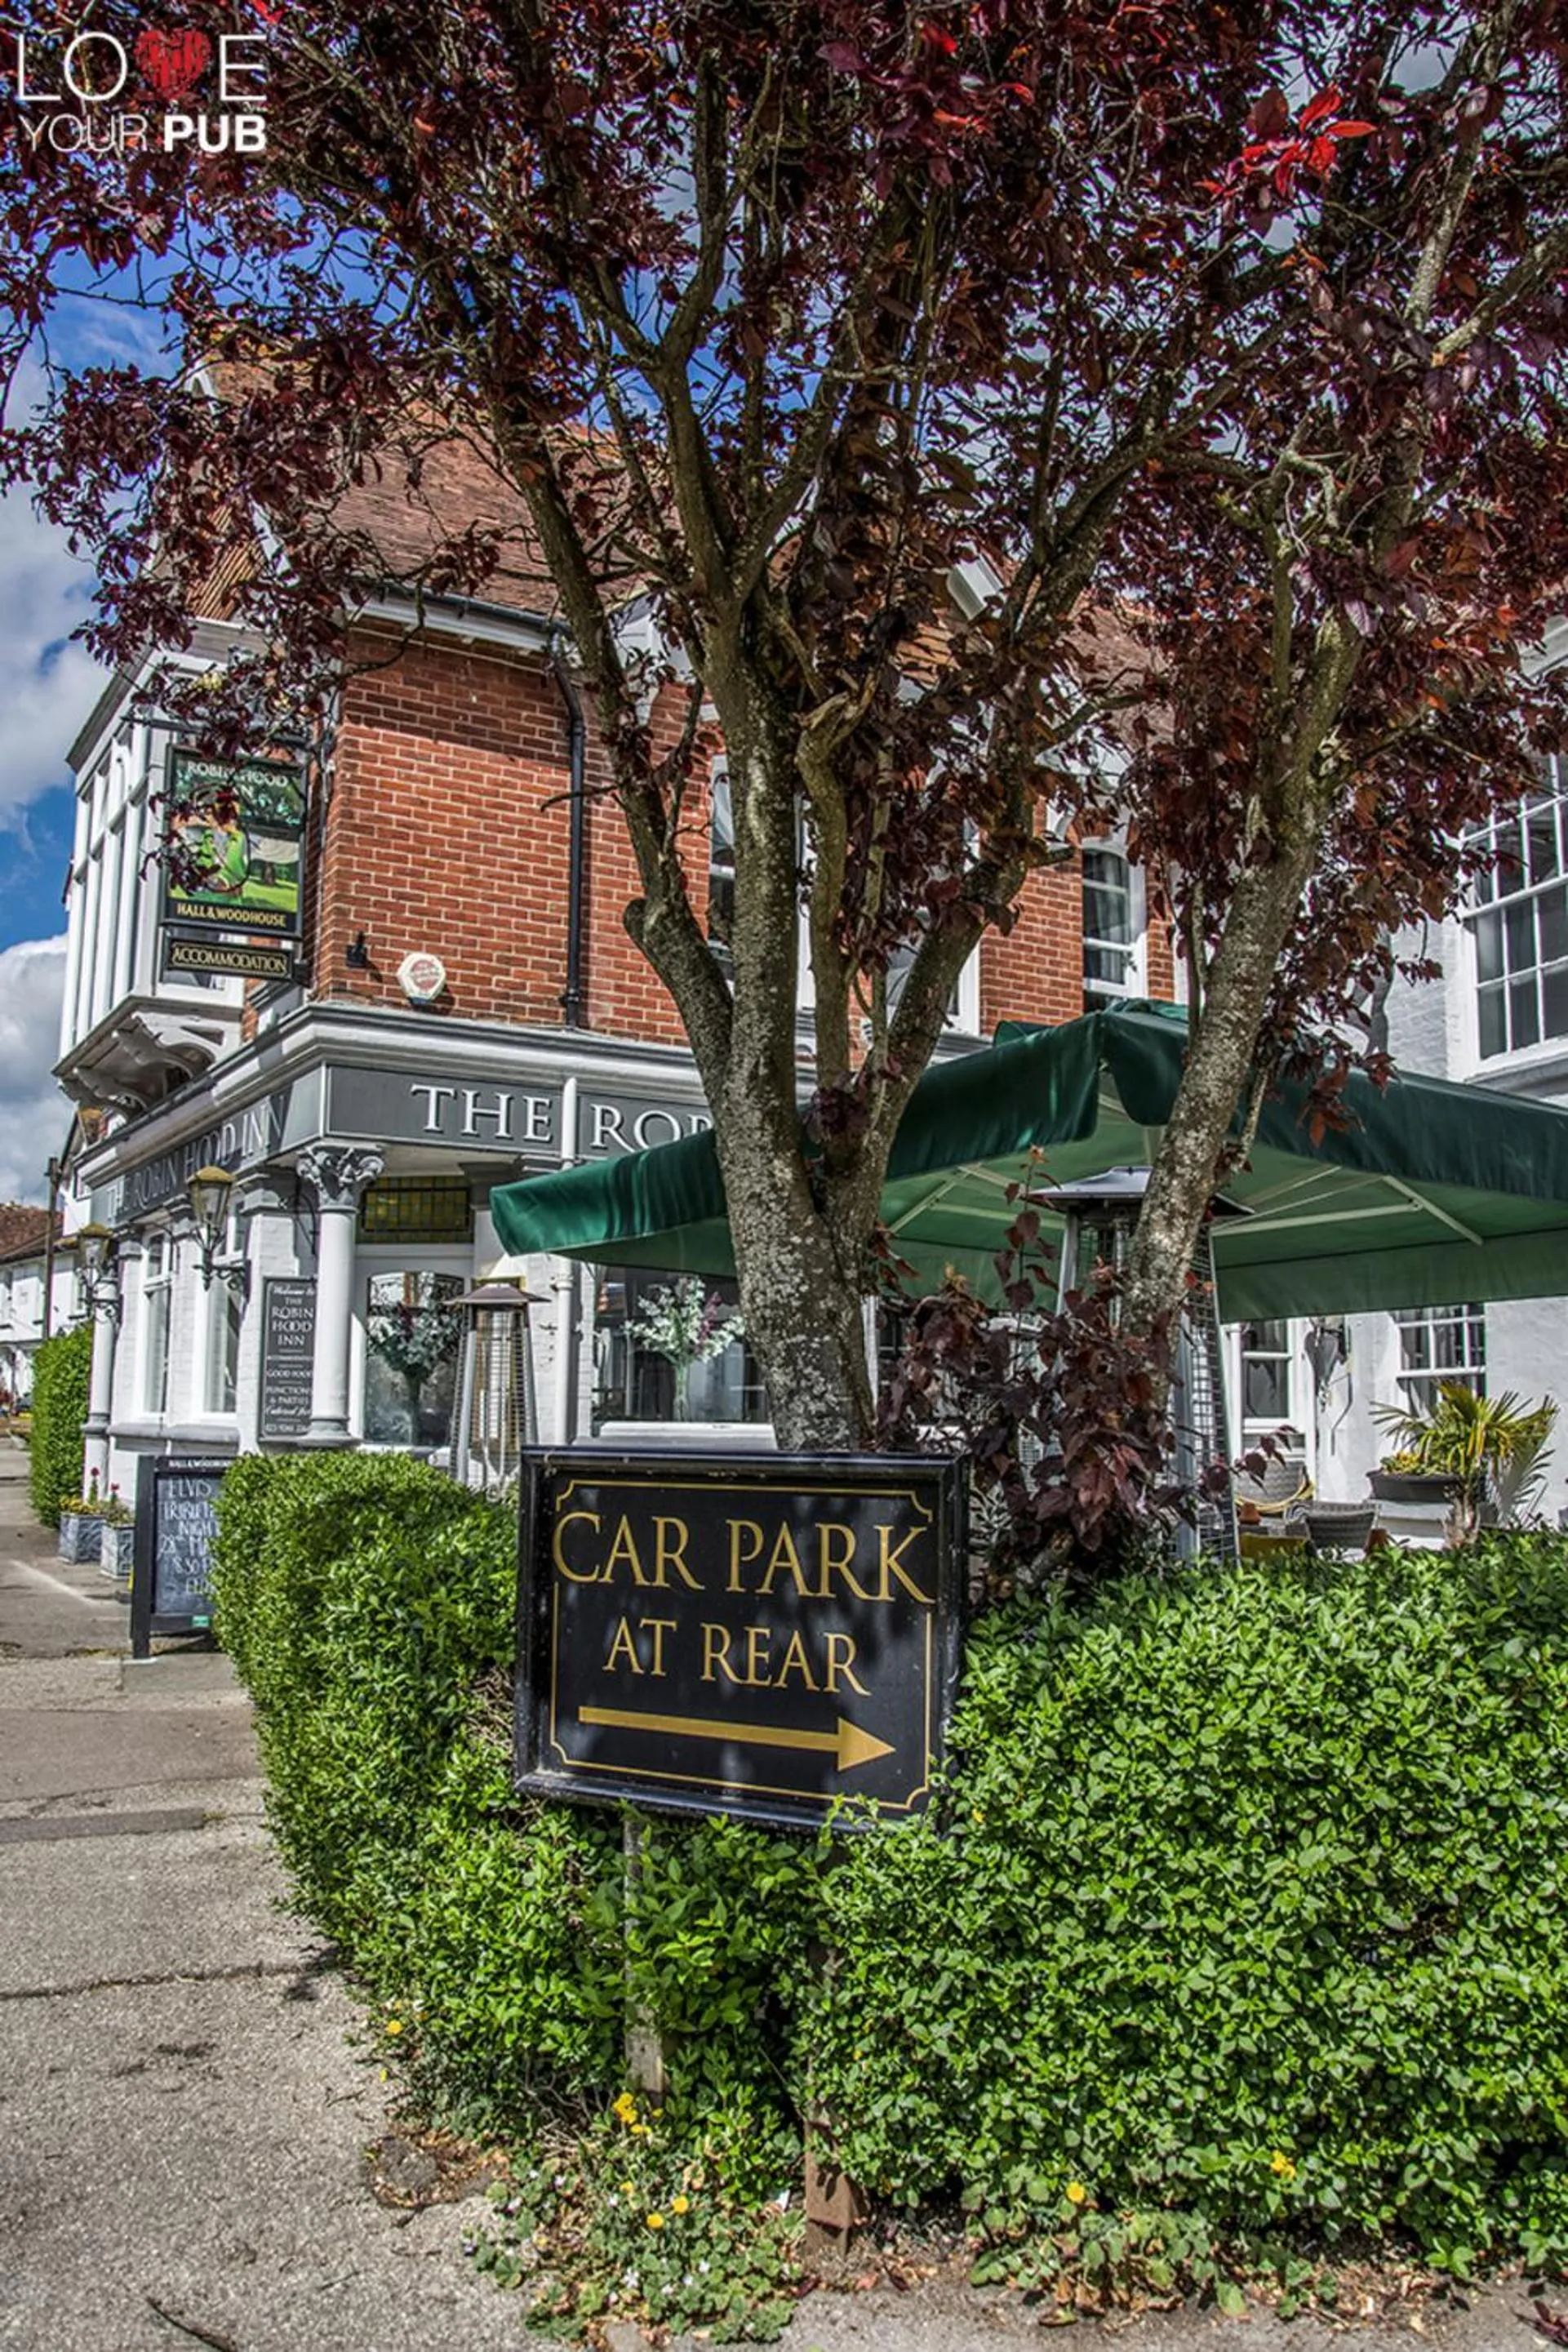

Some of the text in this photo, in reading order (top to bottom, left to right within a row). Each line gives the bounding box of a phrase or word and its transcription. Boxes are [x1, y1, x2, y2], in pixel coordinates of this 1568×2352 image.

[174, 947, 286, 973] ACCOMMODATION
[411, 1083, 553, 1141] THE
[131, 1149, 180, 1210] ROBIN
[184, 1123, 237, 1184] HOOD
[242, 1094, 286, 1157] INN
[271, 1306, 313, 1319] ROBIN
[272, 1320, 313, 1332] HOOD
[278, 1335, 305, 1345] INN
[168, 1478, 211, 1498] ELVIS
[553, 1512, 935, 1604] CAR PARK
[602, 1616, 872, 1696] AT REAR
